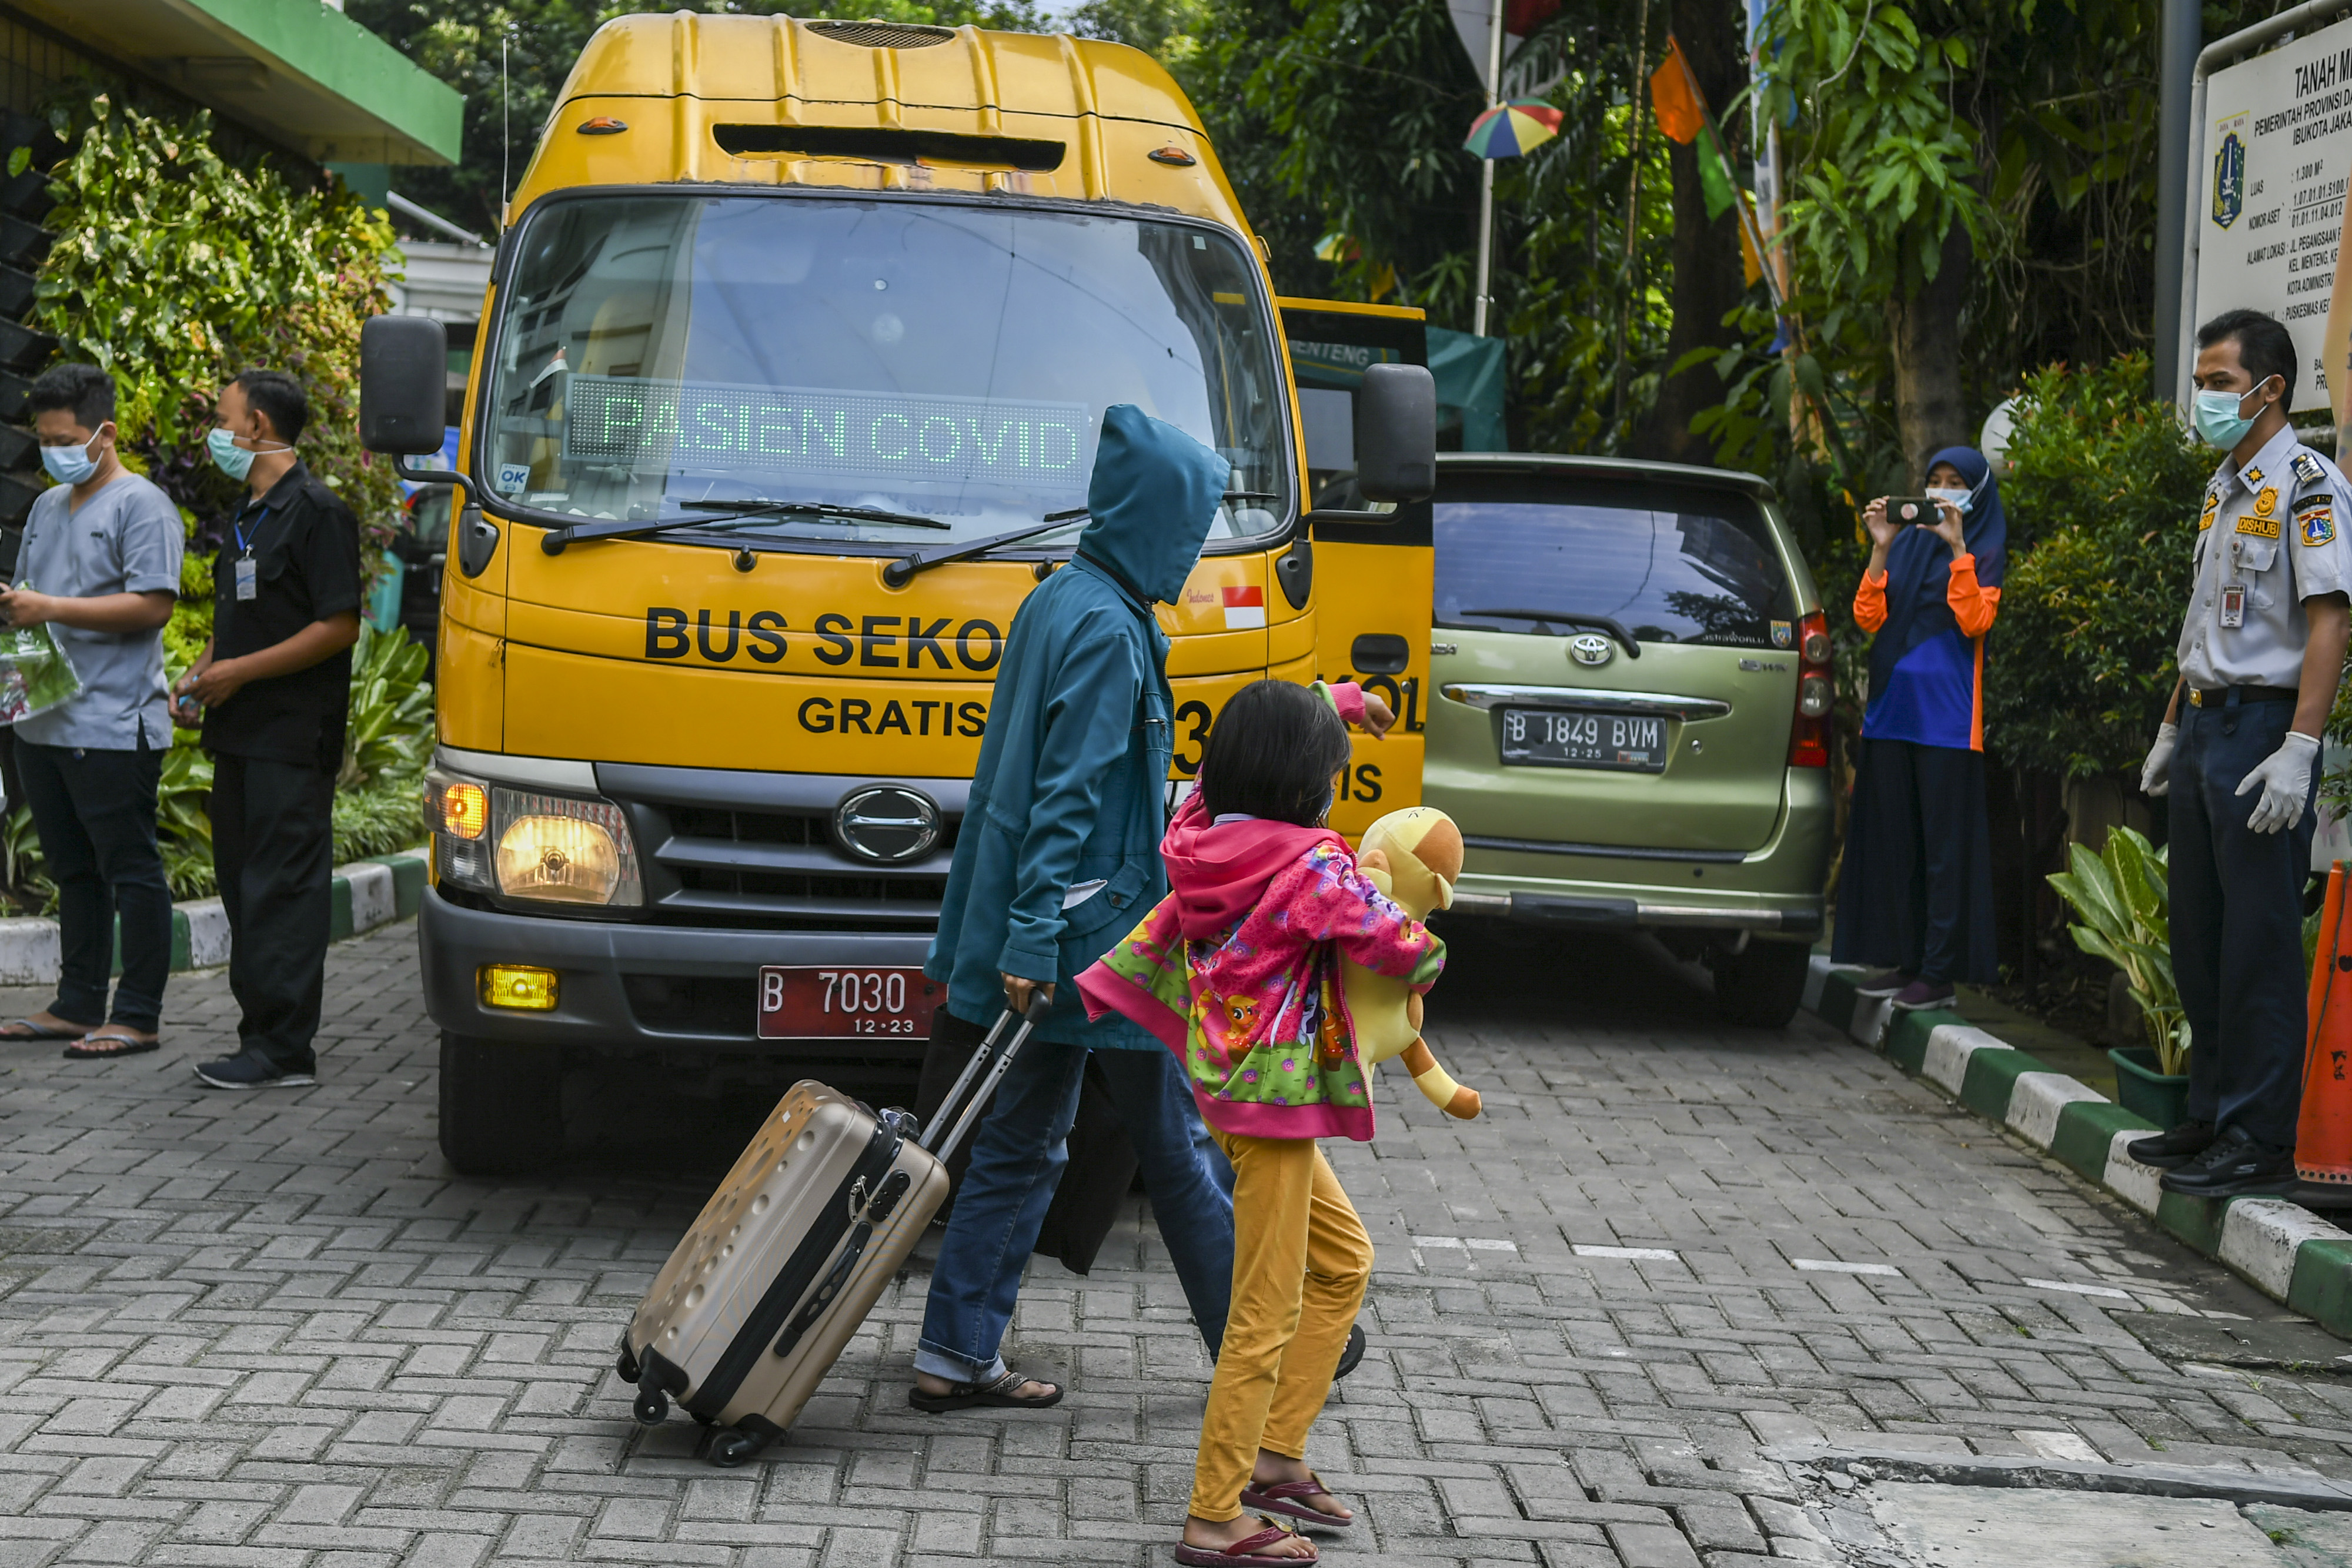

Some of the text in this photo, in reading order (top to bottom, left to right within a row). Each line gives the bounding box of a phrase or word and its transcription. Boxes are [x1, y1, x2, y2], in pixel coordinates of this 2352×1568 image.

[2295, 53, 2337, 99] TANAH
[2254, 105, 2303, 138] PEMERINTAH
[2304, 91, 2342, 121] PROVINSI
[2293, 118, 2328, 146] IBUKOTA
[2250, 179, 2264, 197] LUAS
[2296, 163, 2313, 182] 1.300
[2249, 208, 2281, 230] NOMOR ASET
[2247, 247, 2266, 266] ALAMAT
[2267, 242, 2286, 260] LOKASI
[2298, 228, 2337, 252] PEGANGSAAN
[2330, 248, 2338, 263] KE
[2287, 279, 2301, 296] KOTA
[2286, 300, 2318, 321] PUSKESMAS
[1291, 340, 1369, 366] ENTENG
[603, 396, 1078, 469] PASIEN COVID
[502, 470, 526, 484] OK
[2239, 518, 2277, 534] DISHUB
[645, 607, 1013, 671] BUS SEKO
[797, 697, 987, 737] GRATIS
[1512, 714, 1658, 748] B 1849 BVM
[763, 972, 906, 1014] B 7030
